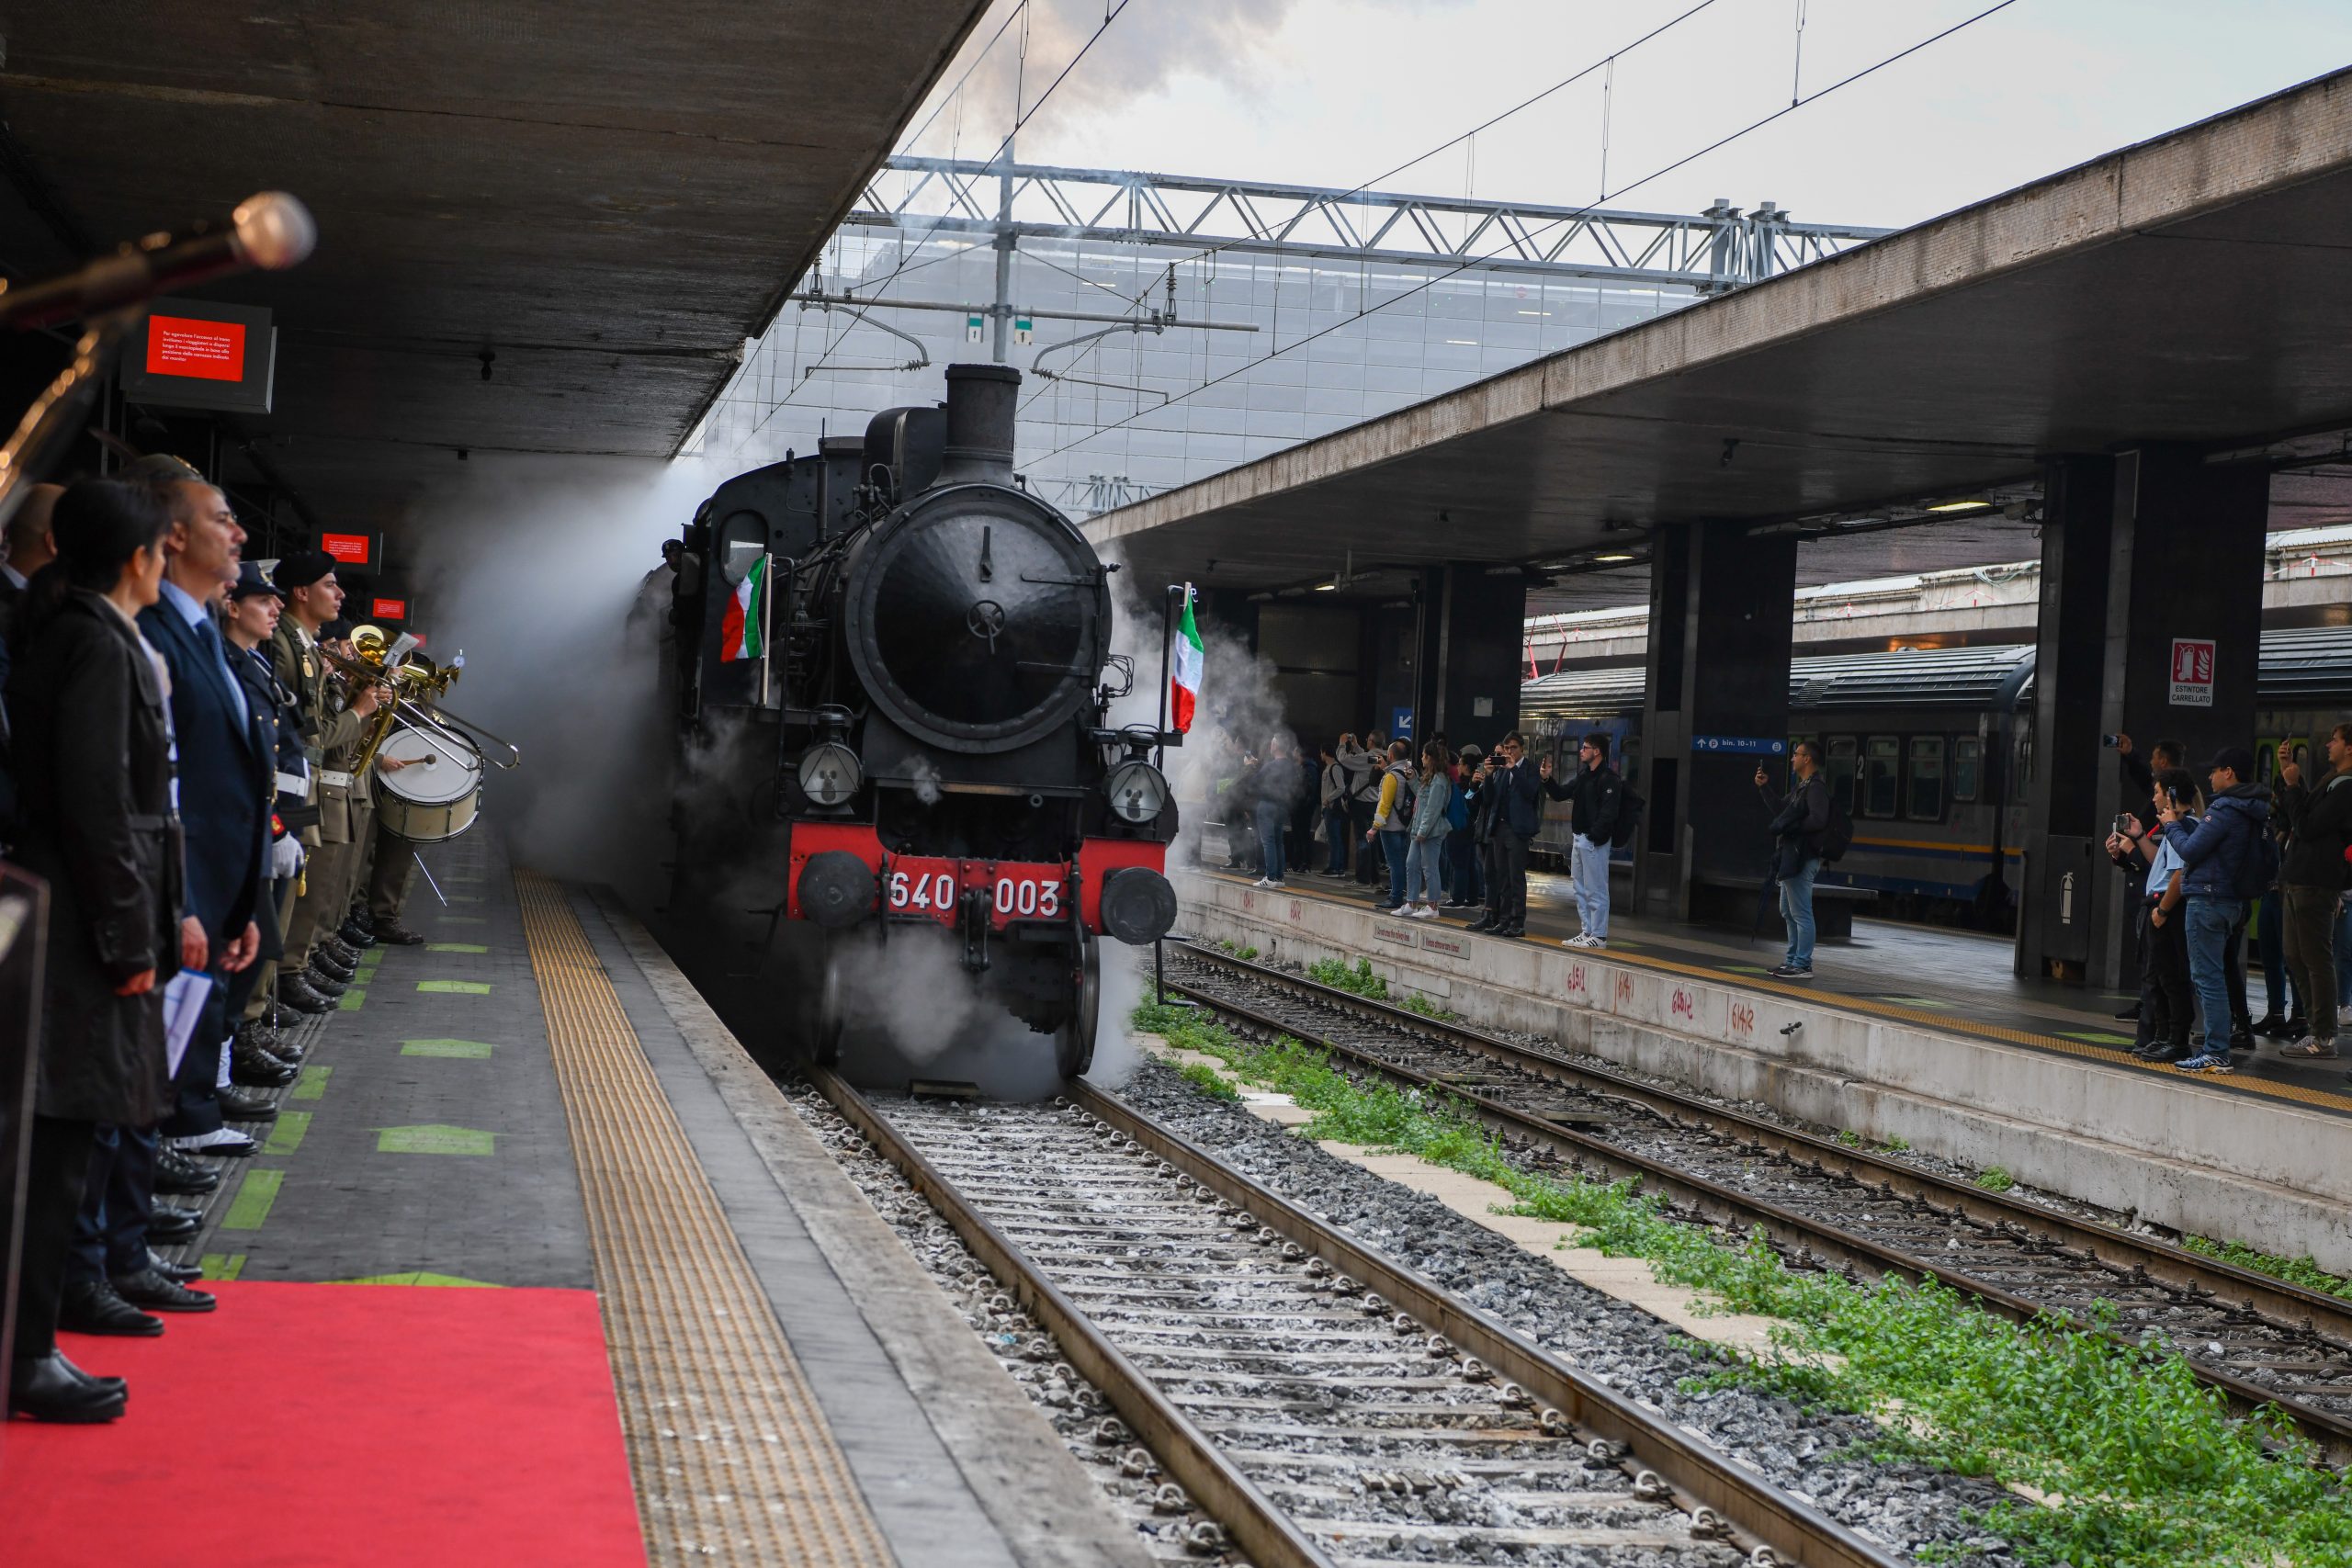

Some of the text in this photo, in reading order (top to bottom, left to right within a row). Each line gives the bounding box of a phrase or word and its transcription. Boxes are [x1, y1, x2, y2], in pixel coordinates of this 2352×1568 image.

[1020, 331, 1025, 344] 1
[2175, 685, 2209, 694] ESTINTORE
[2171, 694, 2211, 704] CARRELLATO
[1856, 755, 1865, 780] 2
[889, 872, 1060, 917] 640 003
